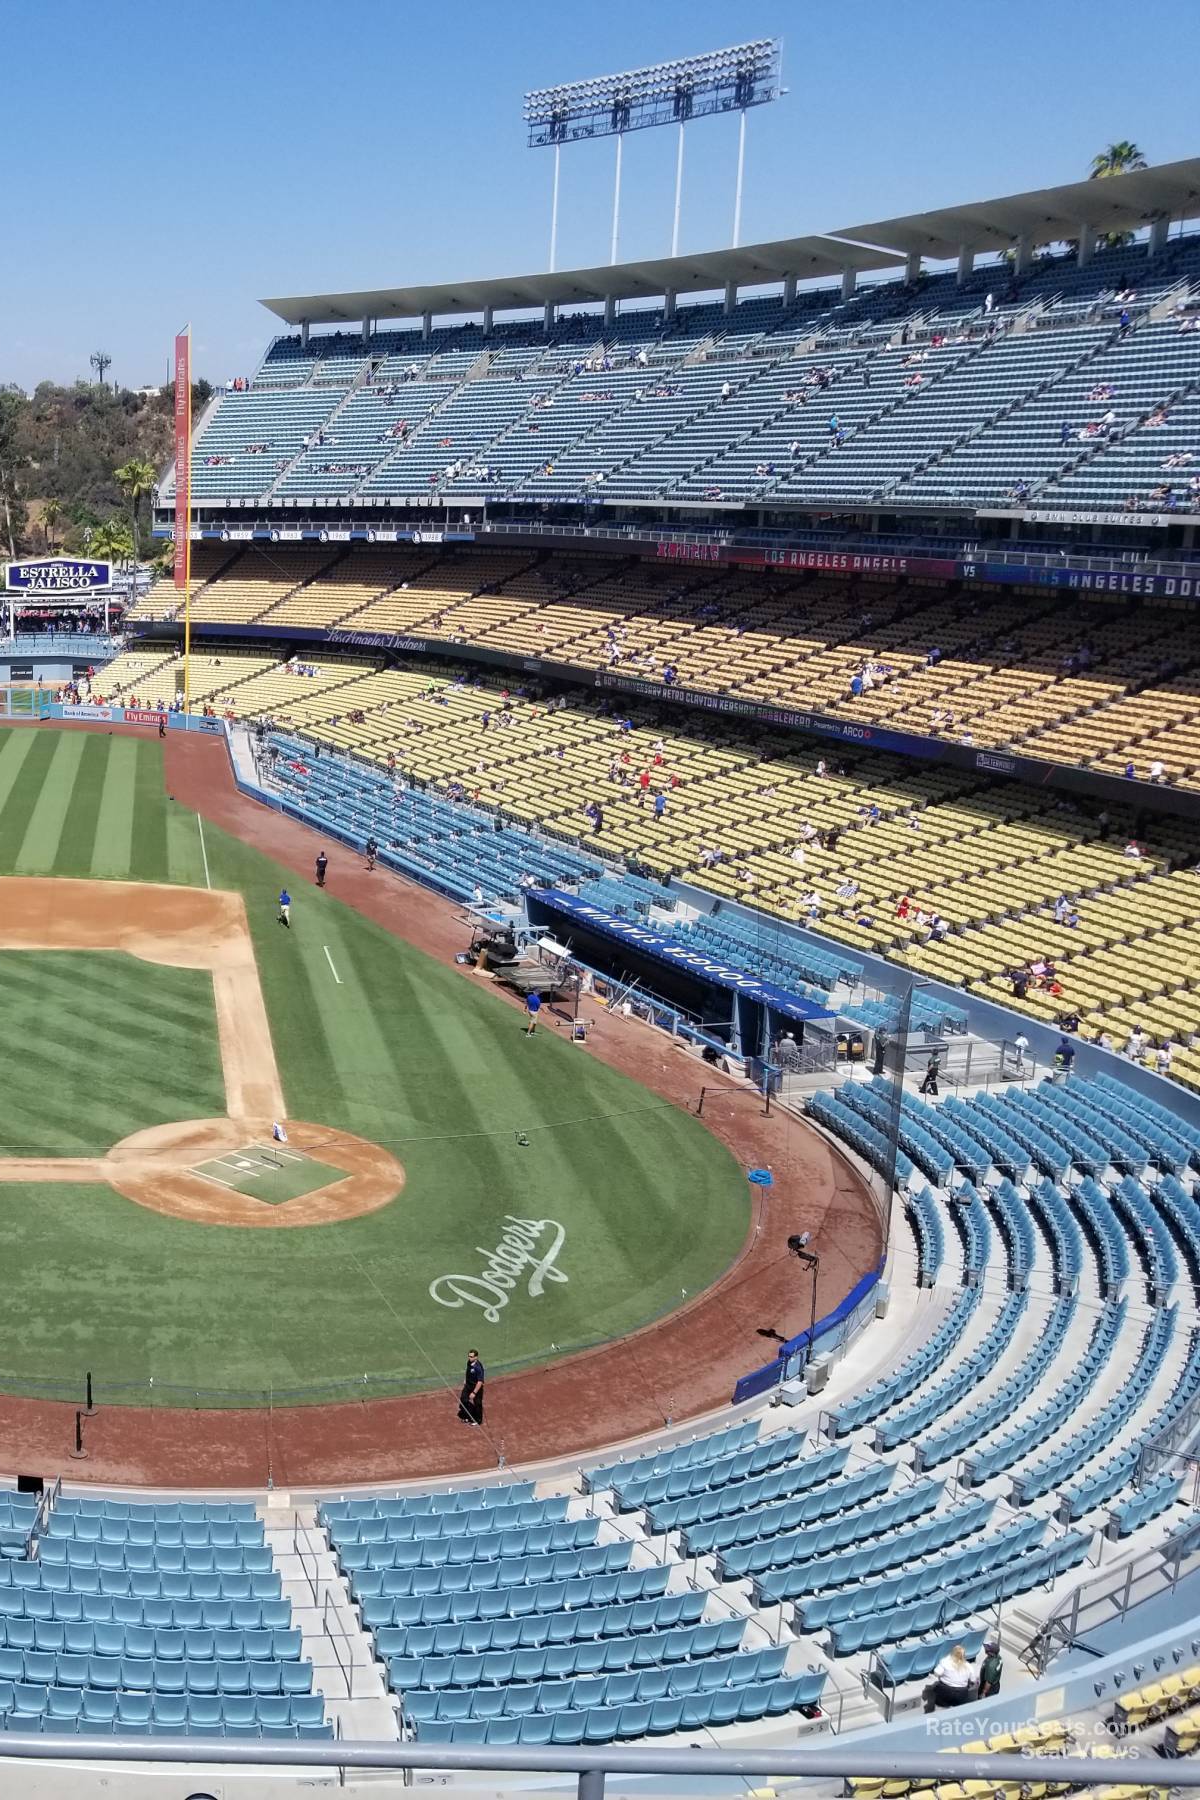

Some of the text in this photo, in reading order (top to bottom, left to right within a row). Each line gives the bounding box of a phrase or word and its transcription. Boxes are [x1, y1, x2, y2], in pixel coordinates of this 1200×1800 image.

[176, 357, 186, 416] Fly Emirates
[176, 435, 186, 474] Emirates
[174, 511, 184, 569] Fly Emirates
[19, 566, 99, 578] ESTRELLA
[27, 577, 91, 588] JALISCO
[765, 550, 785, 563] LOS
[791, 552, 847, 568] ANGELES
[964, 566, 975, 577] VS
[1069, 575, 1154, 593] ANGELES
[126, 711, 138, 721] Fly
[139, 713, 166, 723] Emirats
[662, 689, 684, 701] RETRO
[686, 693, 718, 708] CLAYTON
[843, 725, 864, 738] ARCO
[575, 907, 761, 986] DODGER STADIUM
[429, 1214, 568, 1322] Dodgers
